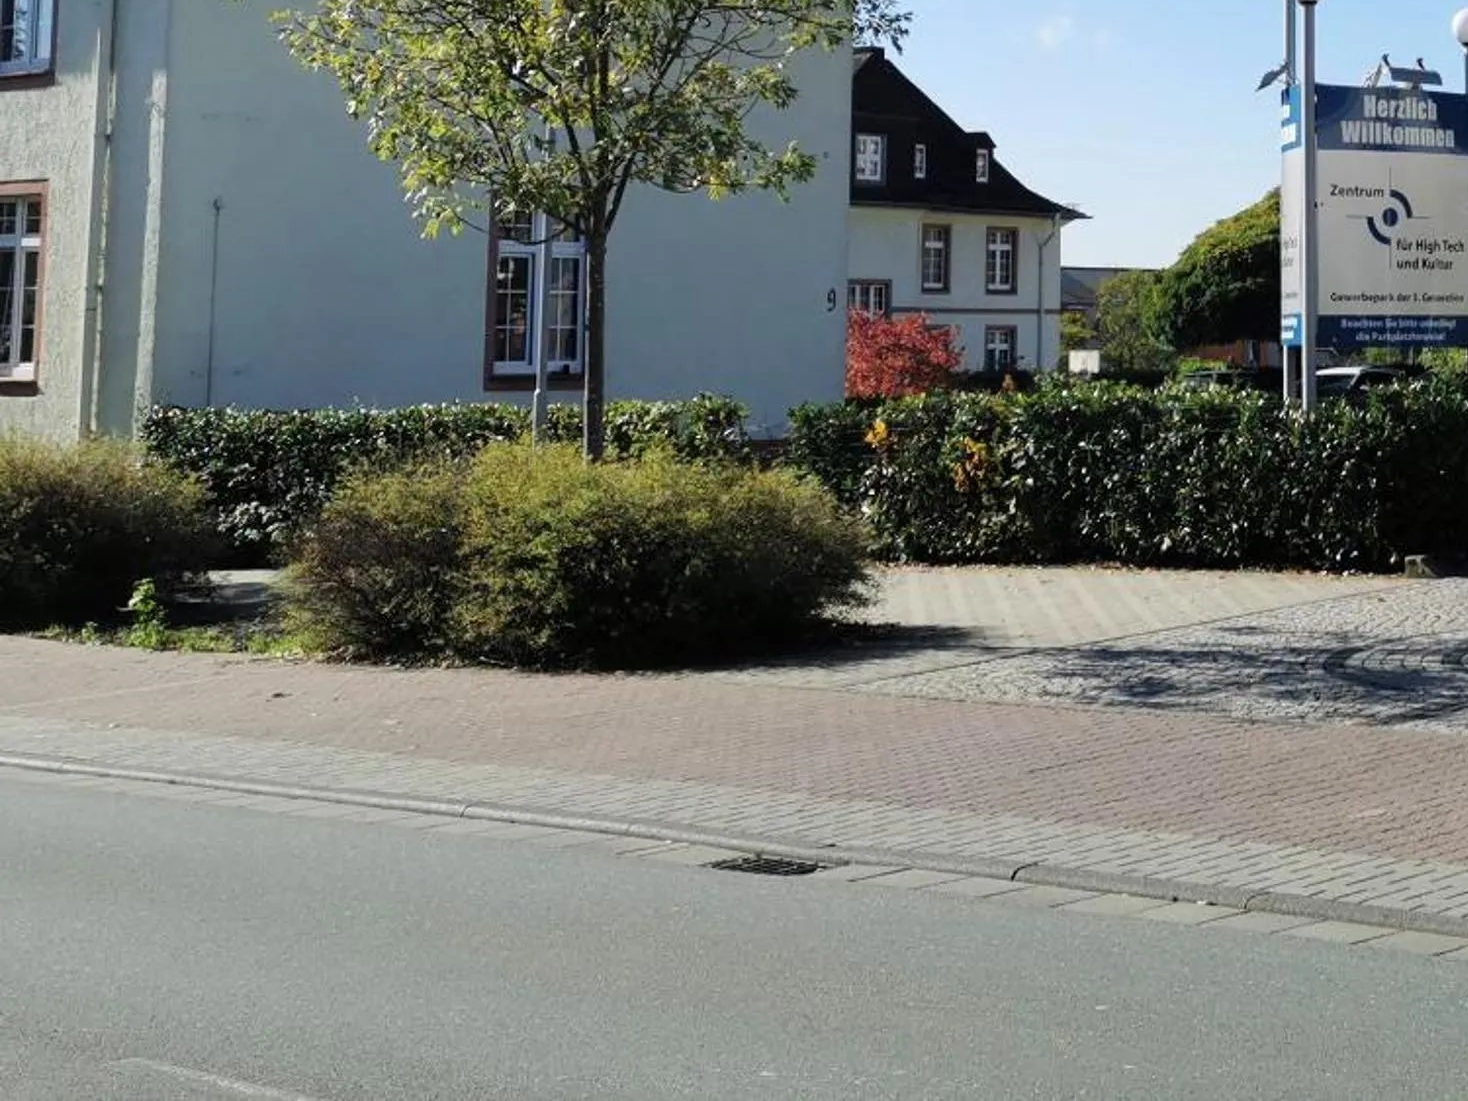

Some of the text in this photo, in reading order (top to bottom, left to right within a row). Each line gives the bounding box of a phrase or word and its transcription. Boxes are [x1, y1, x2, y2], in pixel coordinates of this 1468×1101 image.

[1363, 94, 1438, 121] Herzlich
[1341, 120, 1455, 148] Willkommen
[1330, 184, 1384, 198] Zentrum
[1396, 237, 1464, 254] für High Tech
[1396, 257, 1453, 271] und Kultur
[827, 287, 836, 313] 9
